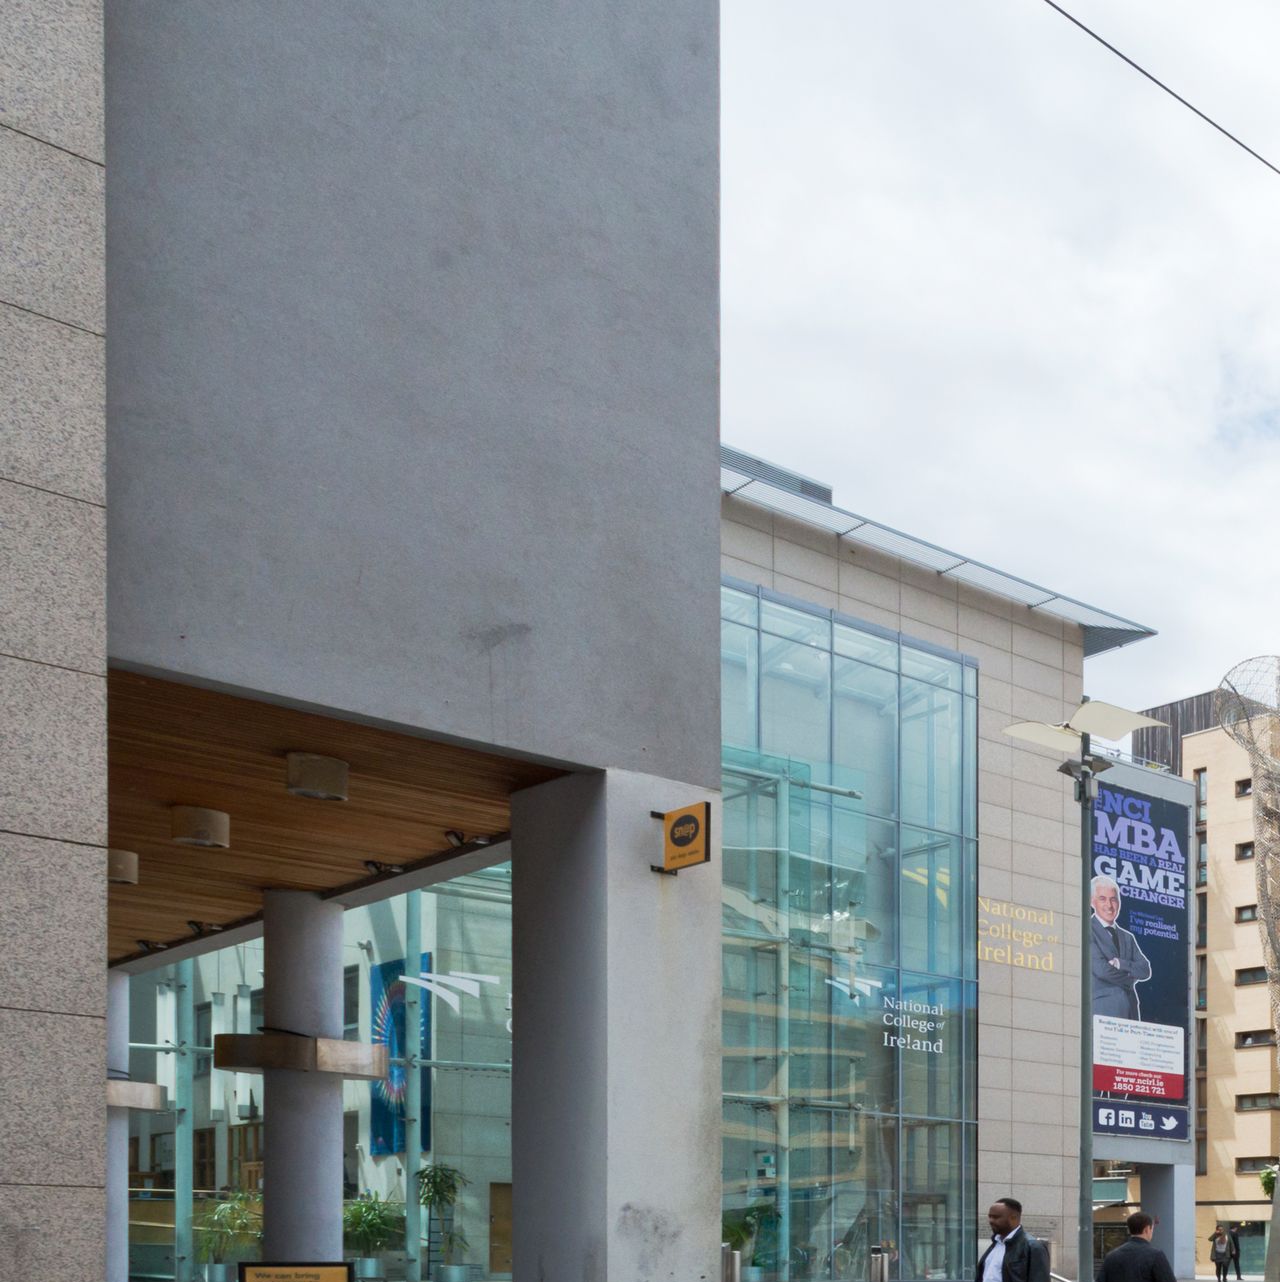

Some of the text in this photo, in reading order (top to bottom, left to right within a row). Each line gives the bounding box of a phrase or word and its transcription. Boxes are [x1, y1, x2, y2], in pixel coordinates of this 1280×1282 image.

[1102, 790, 1151, 823] NCI
[1094, 810, 1185, 864] MBA
[1094, 844, 1185, 874] HAS BEEN A REAL
[1094, 855, 1184, 898] GAME
[1120, 886, 1185, 909] CHANGER
[978, 896, 1054, 927] National
[978, 919, 1043, 948] College
[1144, 928, 1179, 940] potential
[1146, 921, 1176, 931] realised
[883, 996, 944, 1016] National
[882, 1013, 946, 1033] College of
[883, 1032, 943, 1054] Ireland
[1114, 1076, 1164, 1087] www.ncirl.ie
